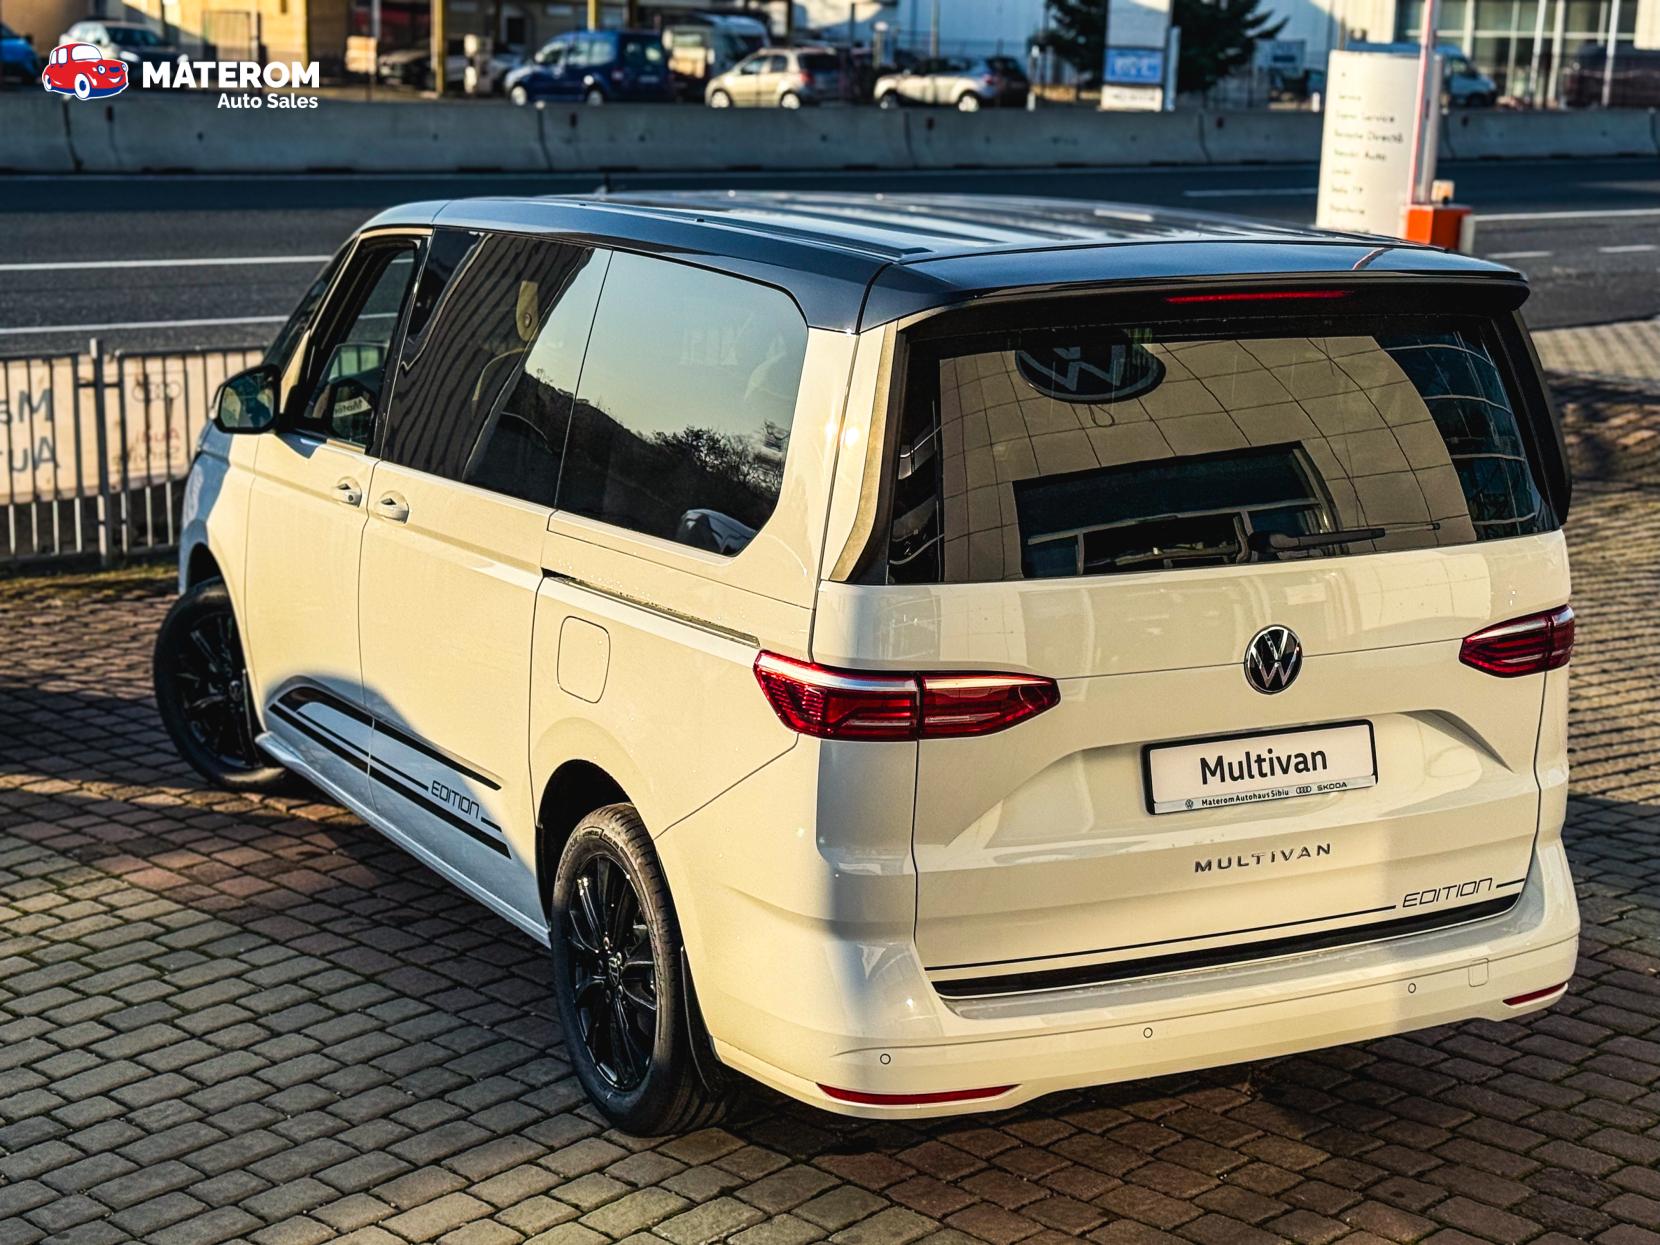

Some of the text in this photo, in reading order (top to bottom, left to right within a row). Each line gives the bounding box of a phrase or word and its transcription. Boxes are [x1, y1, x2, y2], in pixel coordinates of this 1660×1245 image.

[1200, 747, 1328, 785] Multivan
[431, 780, 480, 819] EDITION
[1202, 795, 1235, 807] Materom
[1236, 791, 1271, 803] Autohaus
[1271, 789, 1290, 798] Sibiu
[1194, 843, 1332, 873] MULTIVAN
[1402, 877, 1493, 908] EDITION
